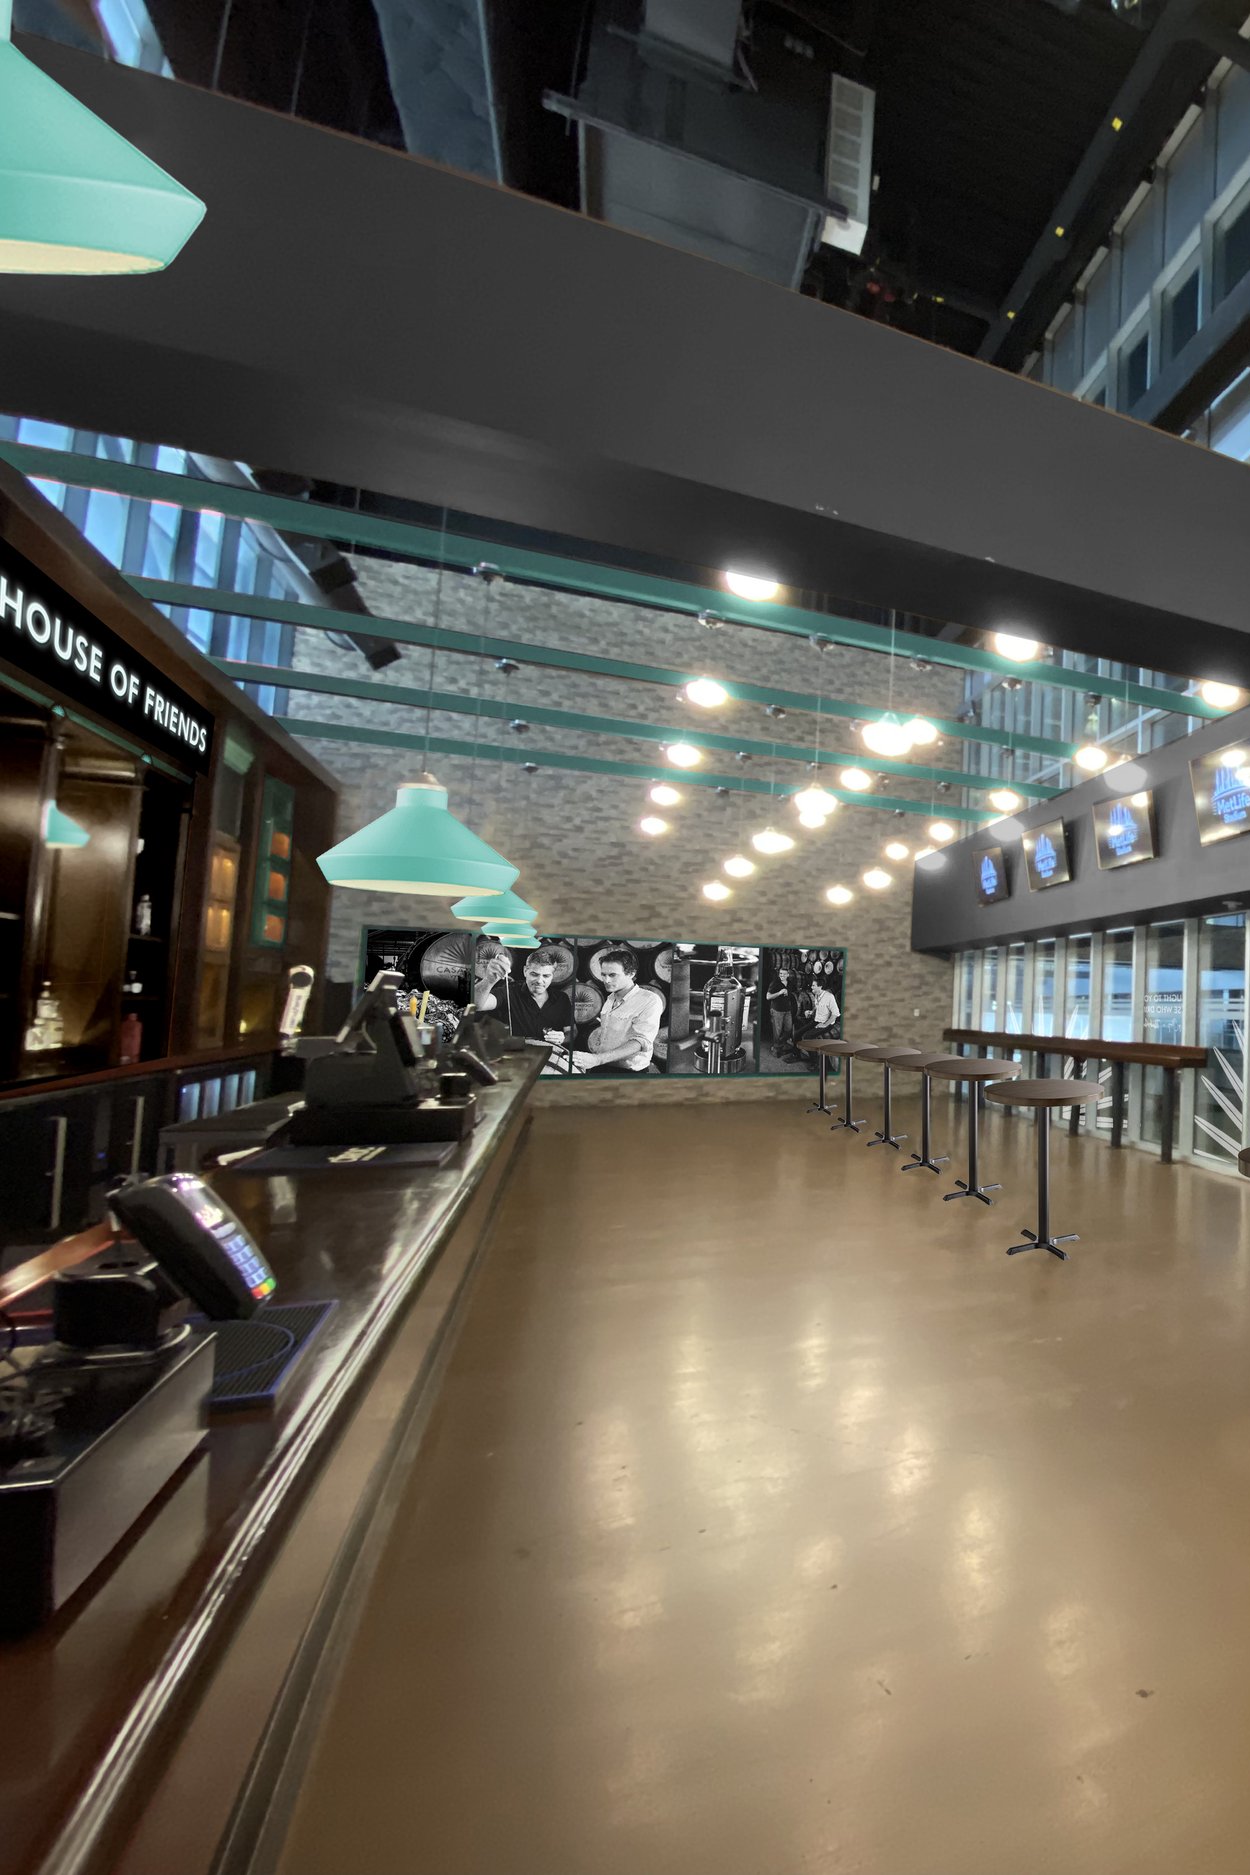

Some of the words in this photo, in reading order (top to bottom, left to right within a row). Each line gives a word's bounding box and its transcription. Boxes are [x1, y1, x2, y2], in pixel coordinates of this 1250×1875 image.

[0, 575, 103, 683] HOUSE
[110, 663, 140, 704] OF
[144, 686, 207, 752] FRIENDS
[1216, 792, 1250, 815] MetLife
